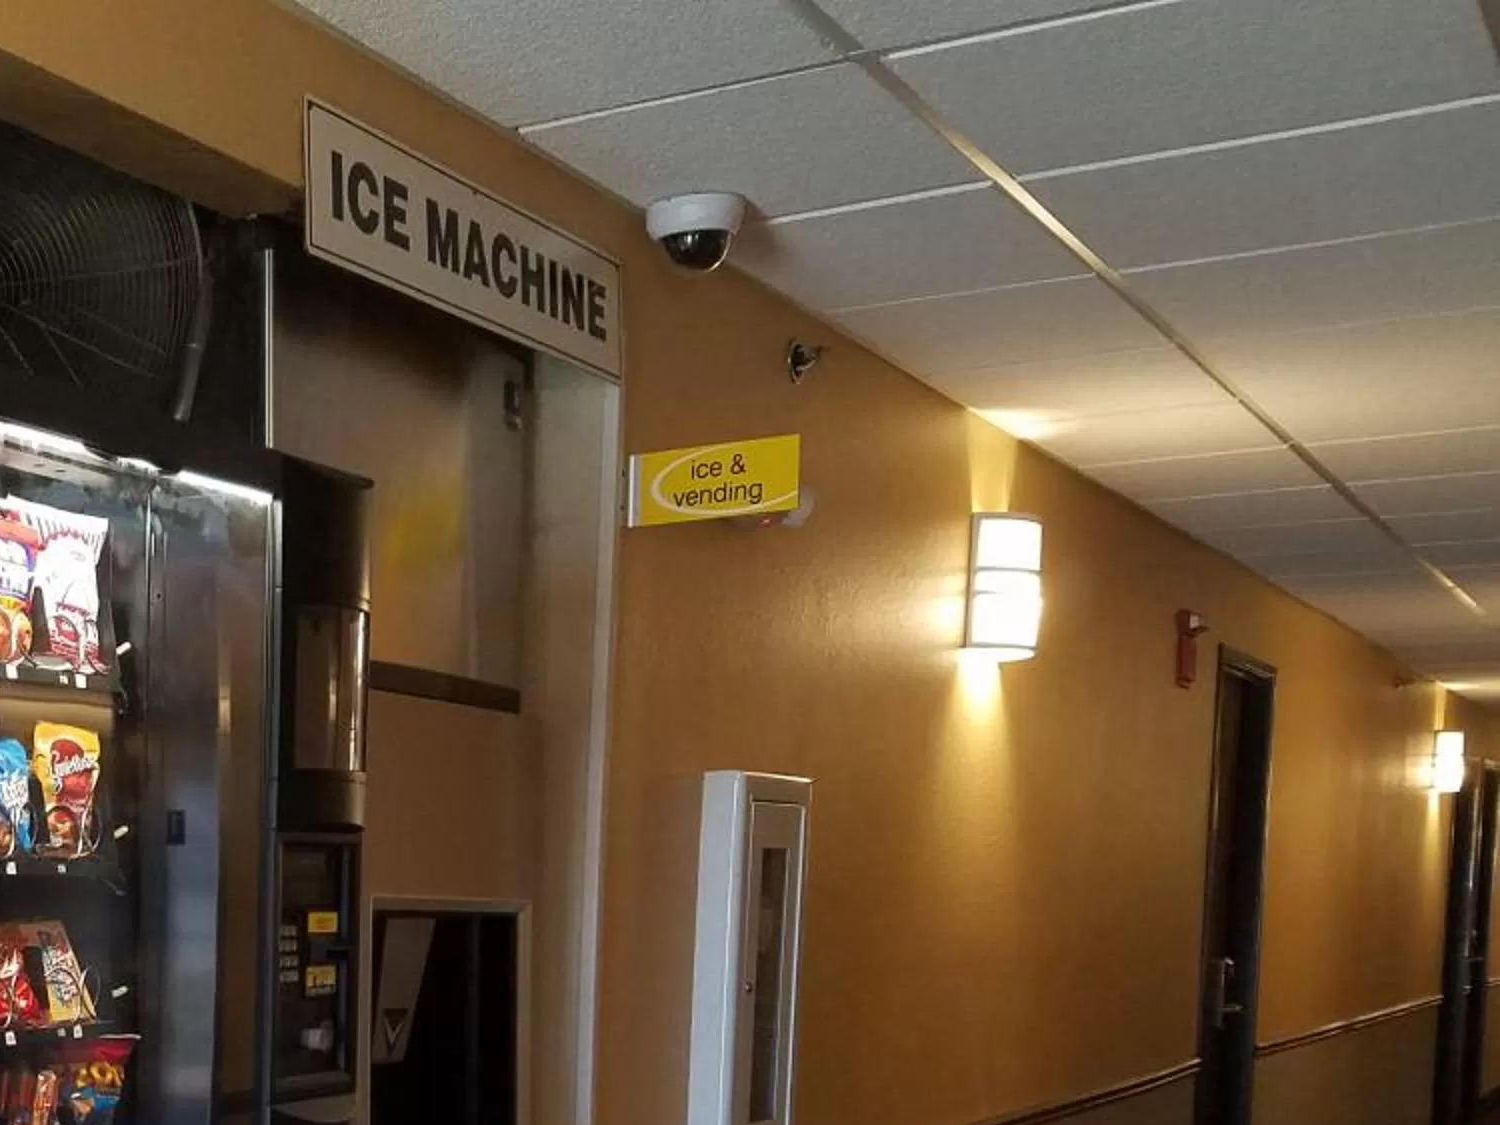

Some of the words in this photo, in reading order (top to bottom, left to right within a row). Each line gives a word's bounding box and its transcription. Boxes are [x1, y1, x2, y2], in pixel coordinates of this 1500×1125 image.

[330, 149, 411, 251] ICE
[424, 197, 608, 342] MACHINE
[690, 460, 722, 479] ice
[730, 453, 747, 474] &
[673, 479, 763, 507] vending
